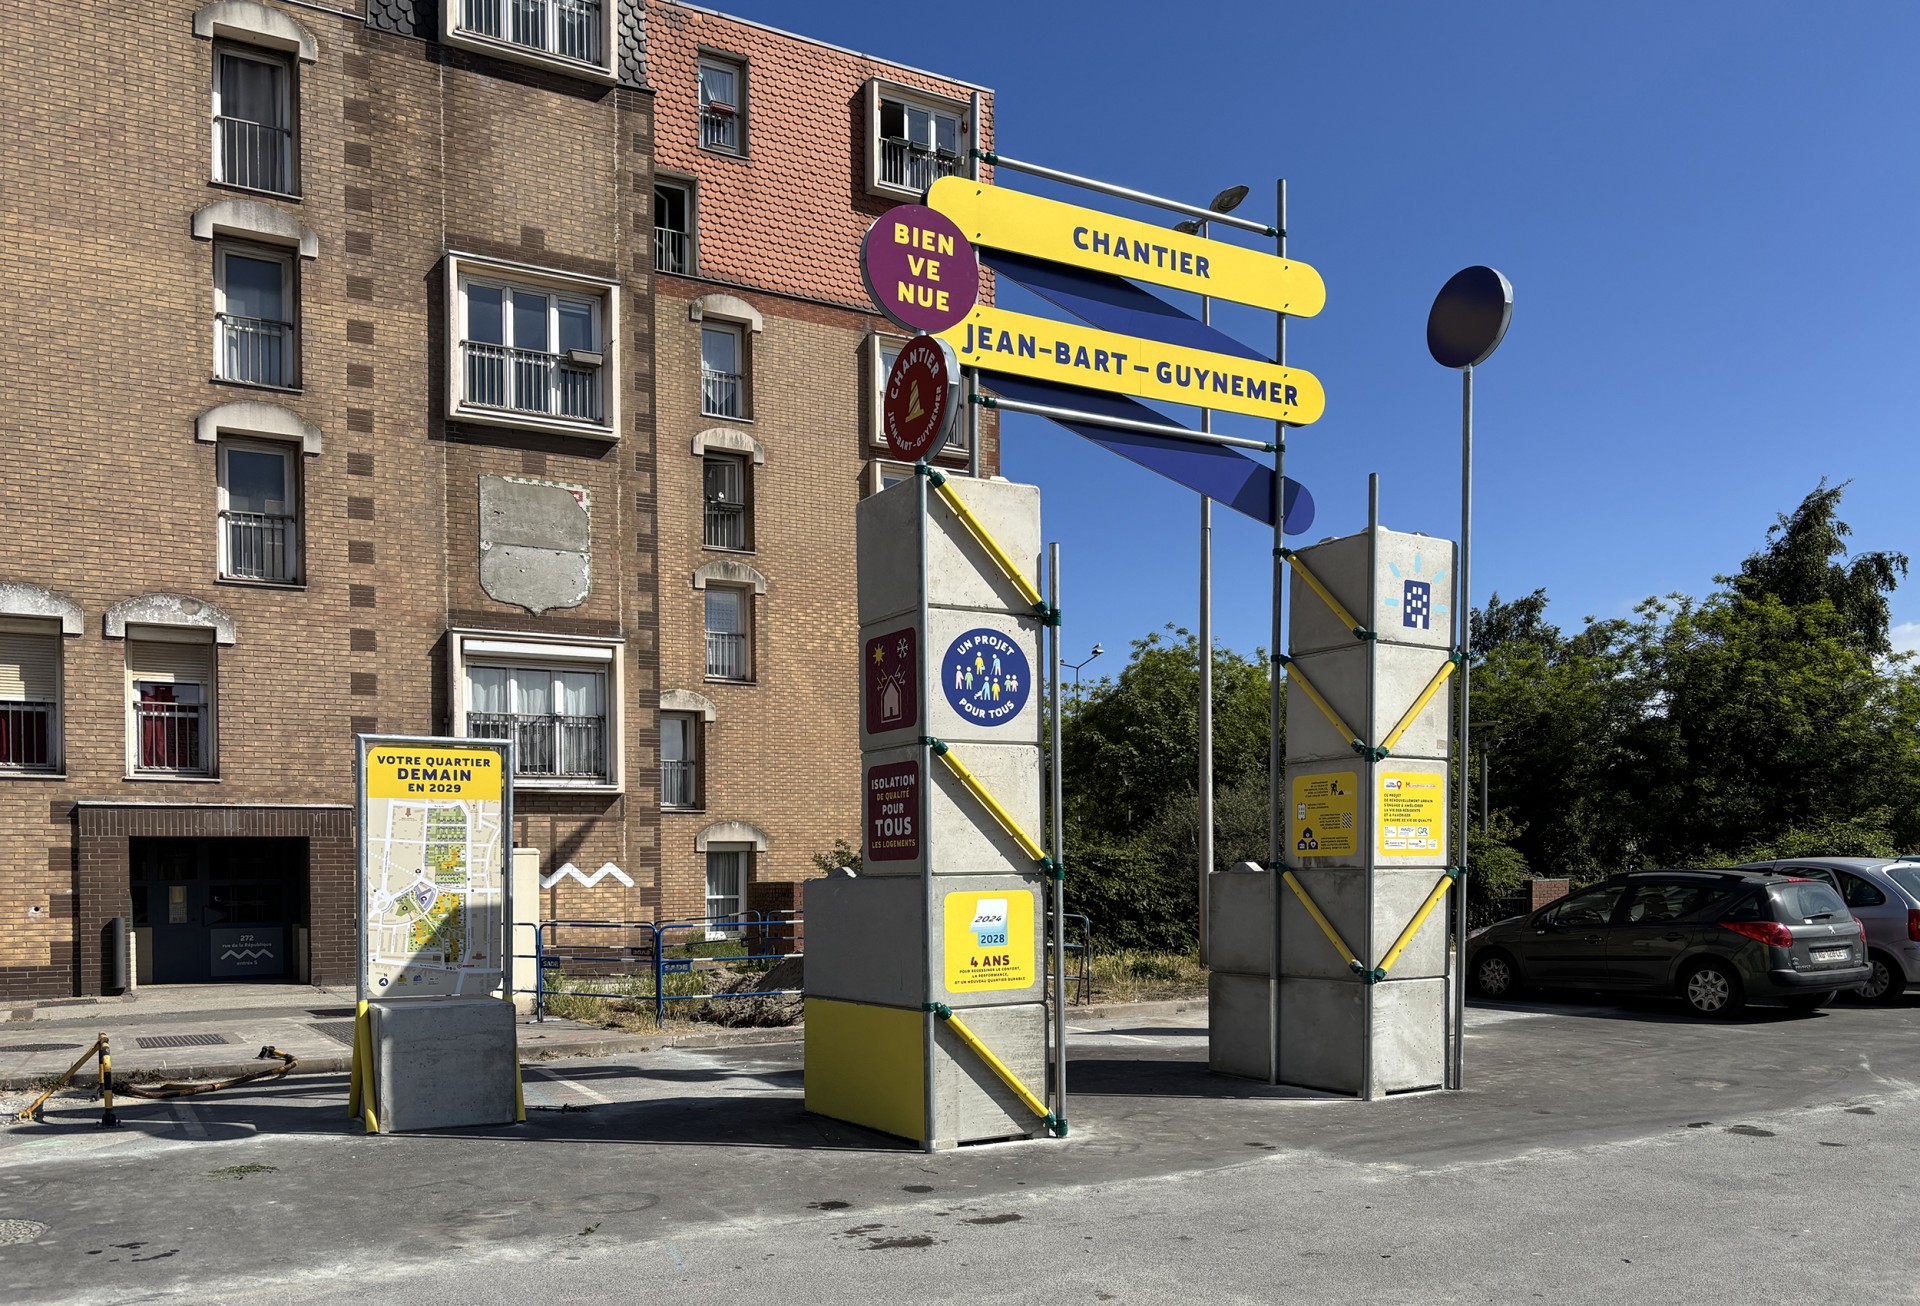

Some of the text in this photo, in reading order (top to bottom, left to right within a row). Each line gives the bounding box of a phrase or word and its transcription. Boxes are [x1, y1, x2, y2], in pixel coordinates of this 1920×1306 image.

[894, 222, 954, 257] BIEN
[1072, 226, 1210, 279] CHANTIER
[907, 254, 940, 281] VE
[898, 281, 950, 312] NUE
[890, 348, 939, 400] CHANTIER
[957, 635, 1014, 655] UN PROJET
[958, 698, 1014, 718] POUR TOUS
[377, 756, 491, 767] VOTRE QUARTIER
[397, 768, 471, 781] DEMAIN
[872, 774, 915, 790] ISOLATION
[408, 783, 461, 792] EN 2029
[885, 787, 910, 801] QUALITÉ
[882, 803, 904, 815] POUR
[875, 817, 912, 837] TOUS
[883, 839, 916, 848] LOGEMENTS
[981, 934, 1005, 944] 2028
[970, 955, 1010, 967] 4 ANS
